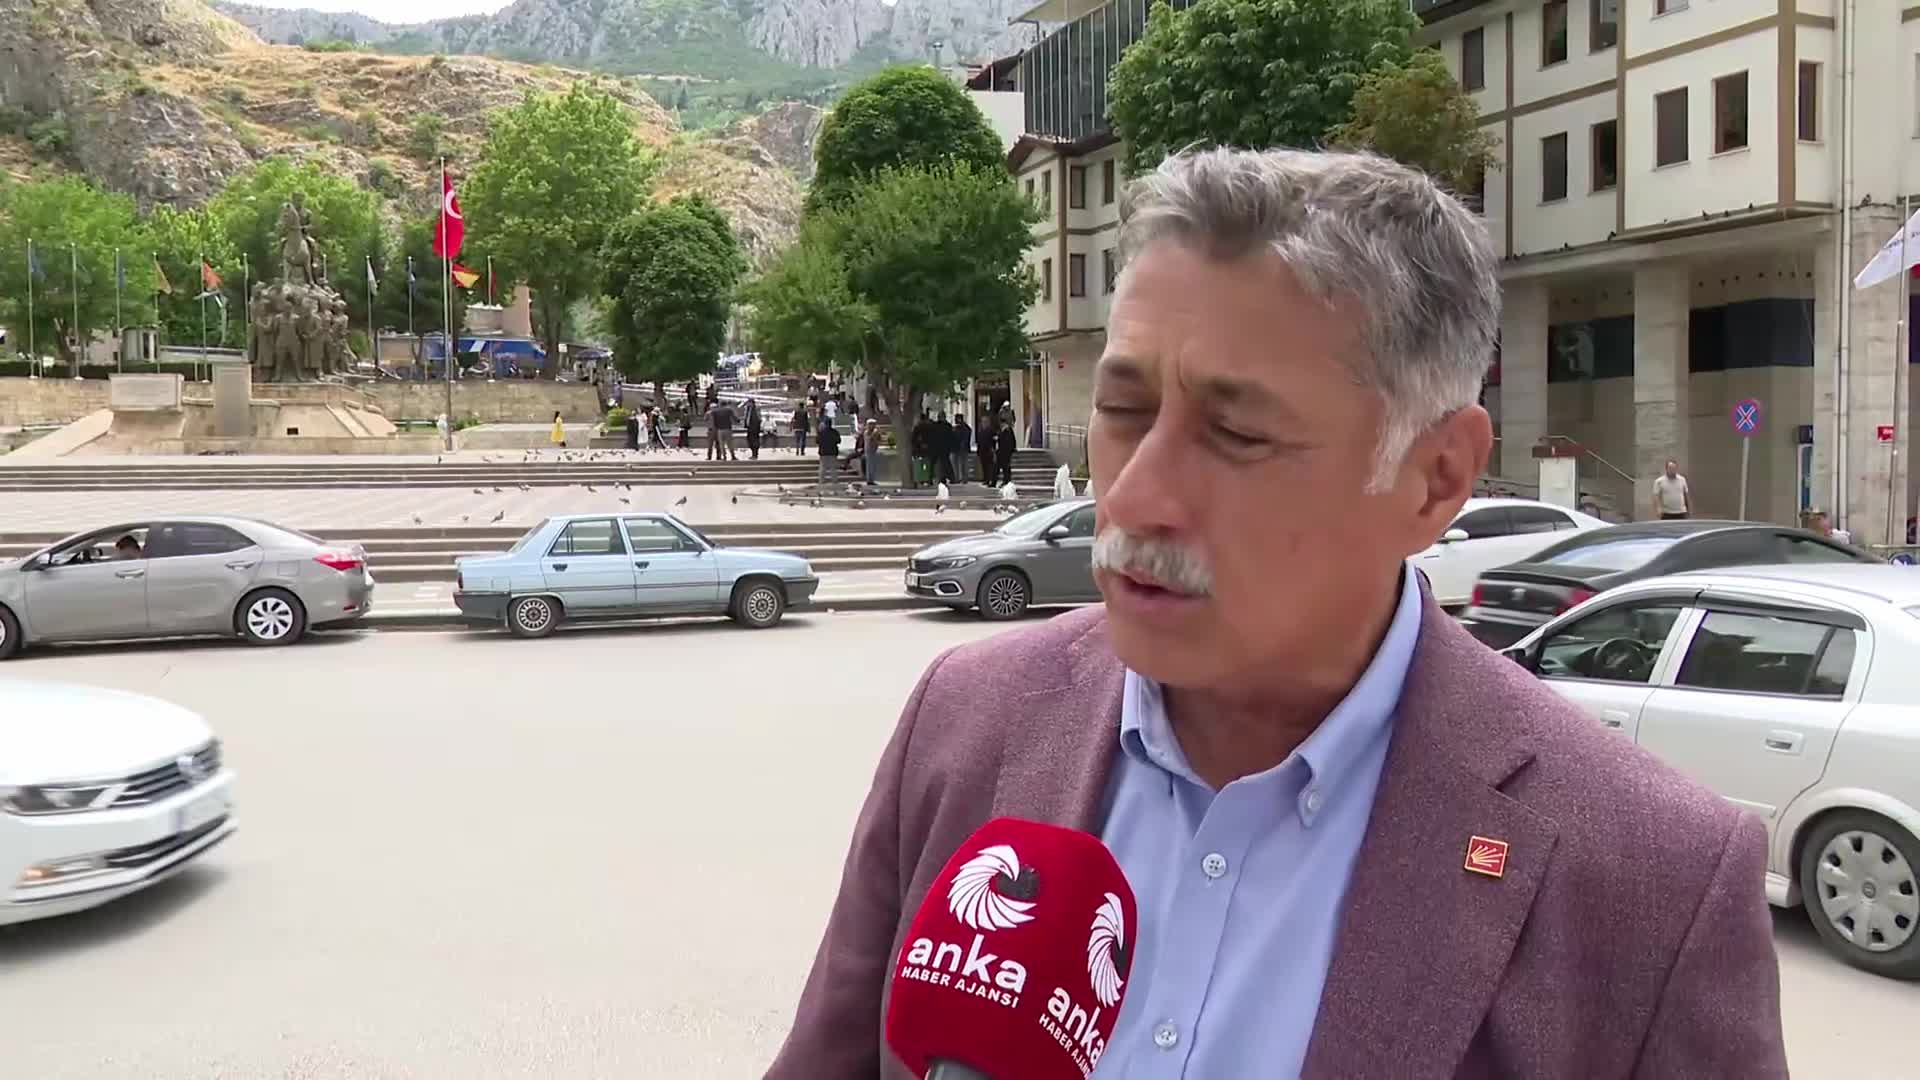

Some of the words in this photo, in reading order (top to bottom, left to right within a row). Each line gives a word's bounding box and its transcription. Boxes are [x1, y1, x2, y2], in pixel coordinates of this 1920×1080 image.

[901, 966, 951, 987] HABER
[954, 978, 1019, 1008] AJANSI
[907, 933, 1027, 994] anka
[1039, 1013, 1073, 1052] HABER
[1047, 987, 1104, 1069] anka
